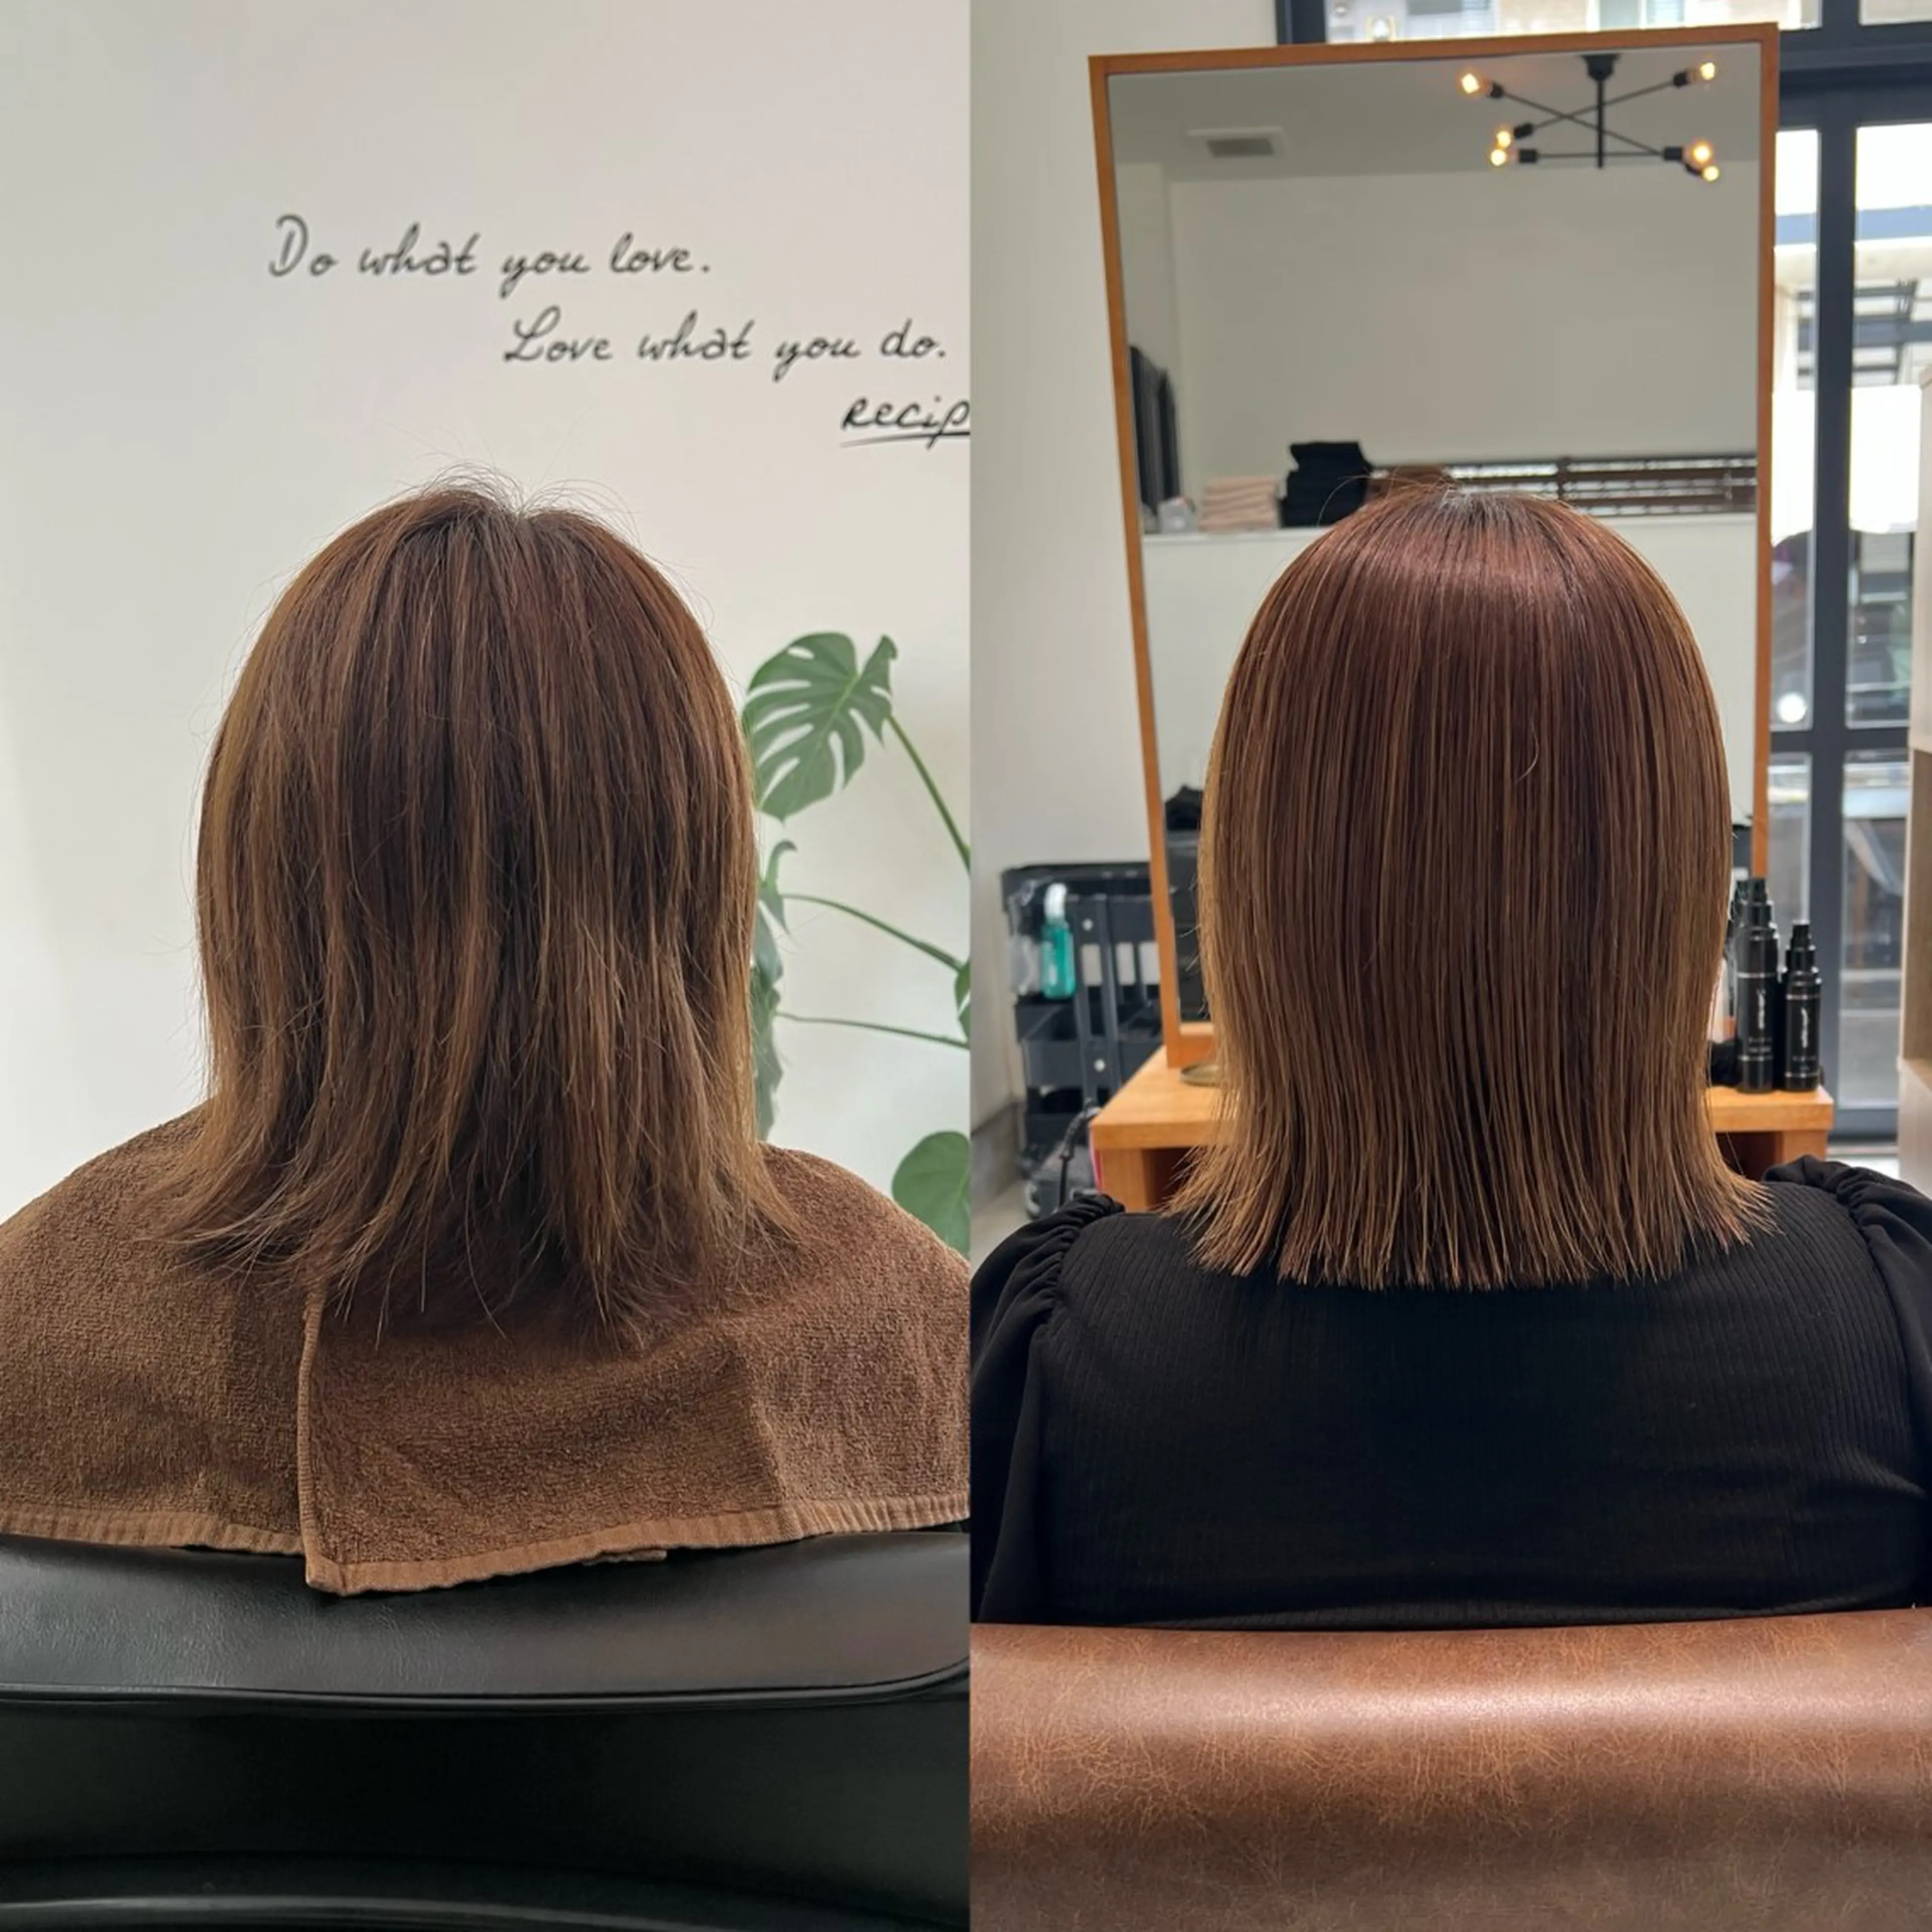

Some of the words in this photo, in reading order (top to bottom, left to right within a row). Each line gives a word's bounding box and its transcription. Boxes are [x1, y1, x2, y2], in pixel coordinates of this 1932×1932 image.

[268, 213, 338, 278] Do
[358, 222, 480, 277] what
[499, 251, 591, 300] you
[609, 231, 710, 274] love.
[502, 304, 613, 363] Love
[637, 309, 755, 361] what
[772, 337, 861, 384] you
[879, 318, 946, 359] do.
